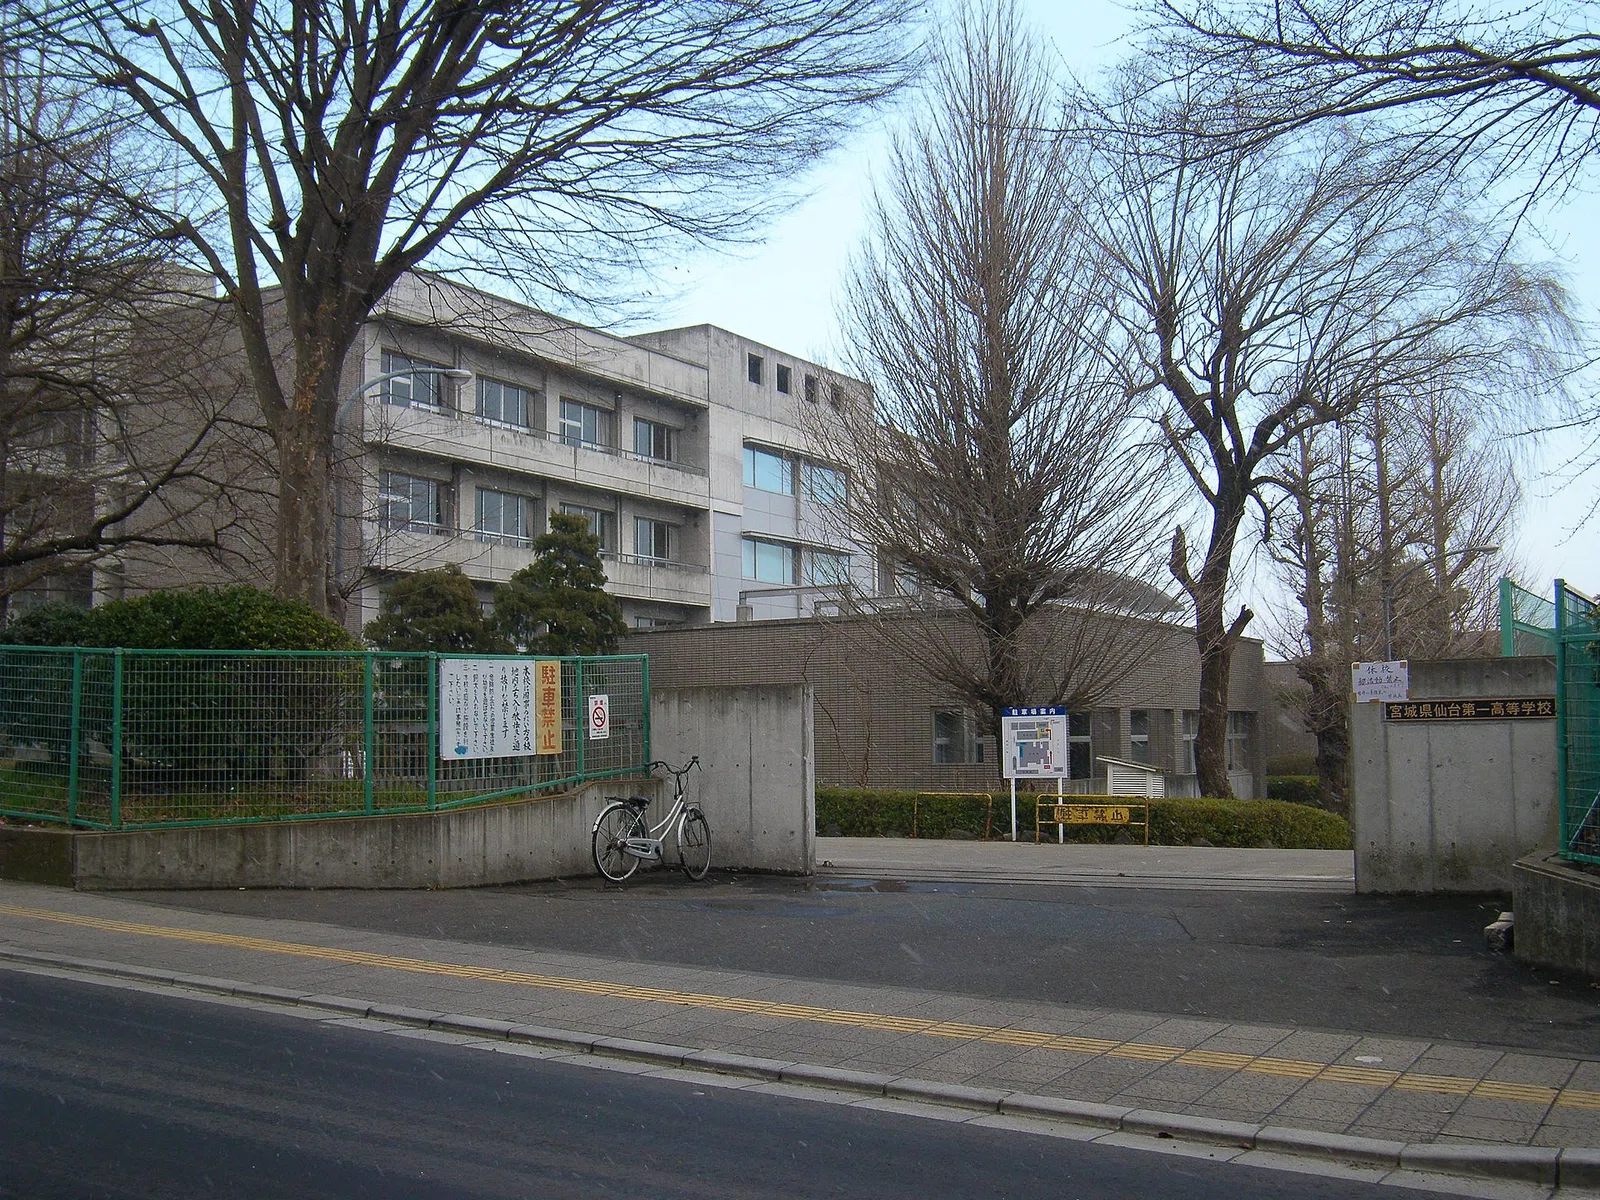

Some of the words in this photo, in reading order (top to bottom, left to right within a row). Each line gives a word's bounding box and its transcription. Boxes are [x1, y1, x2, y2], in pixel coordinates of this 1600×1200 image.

[541, 665, 557, 750] 駐車禁止
[1389, 700, 1553, 718] 宮城県仙台第一高等学校
